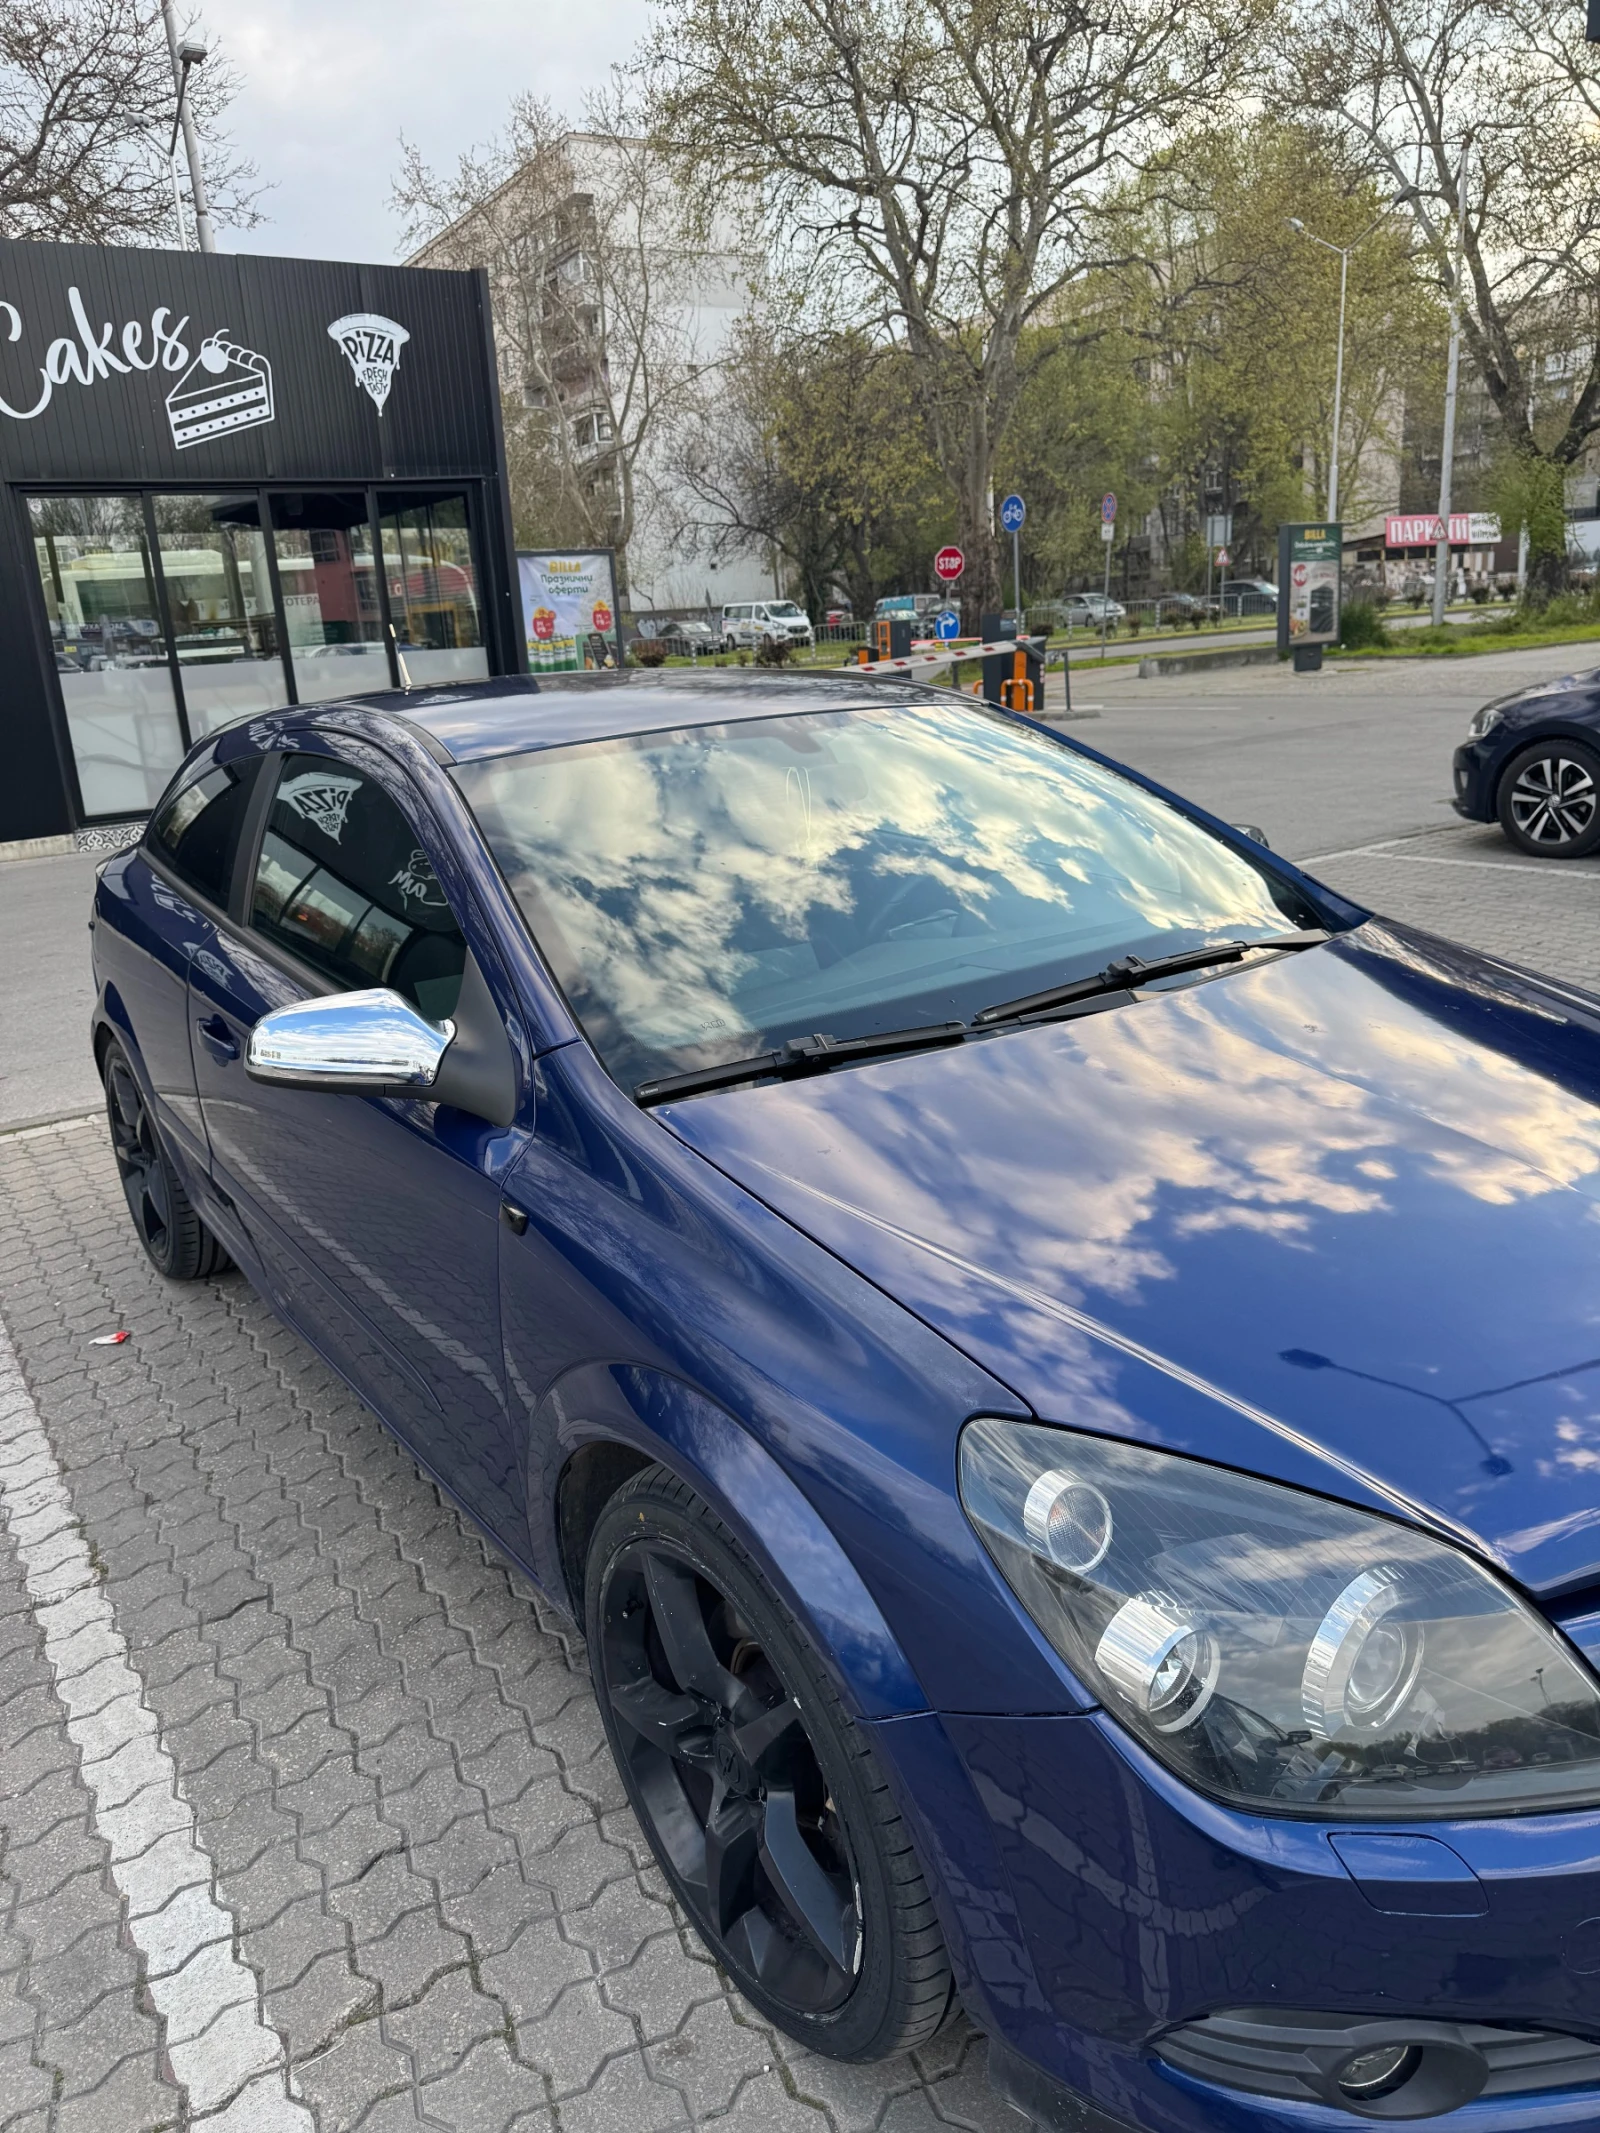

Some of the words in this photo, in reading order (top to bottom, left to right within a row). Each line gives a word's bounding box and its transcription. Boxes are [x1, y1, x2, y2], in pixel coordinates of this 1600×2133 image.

[362, 367, 388, 382] FRESH
[367, 382, 388, 395] TASTY
[549, 561, 581, 573] BILLA
[939, 557, 961, 570] STOP
[541, 574, 593, 585] Празнични
[549, 585, 588, 595] оферти
